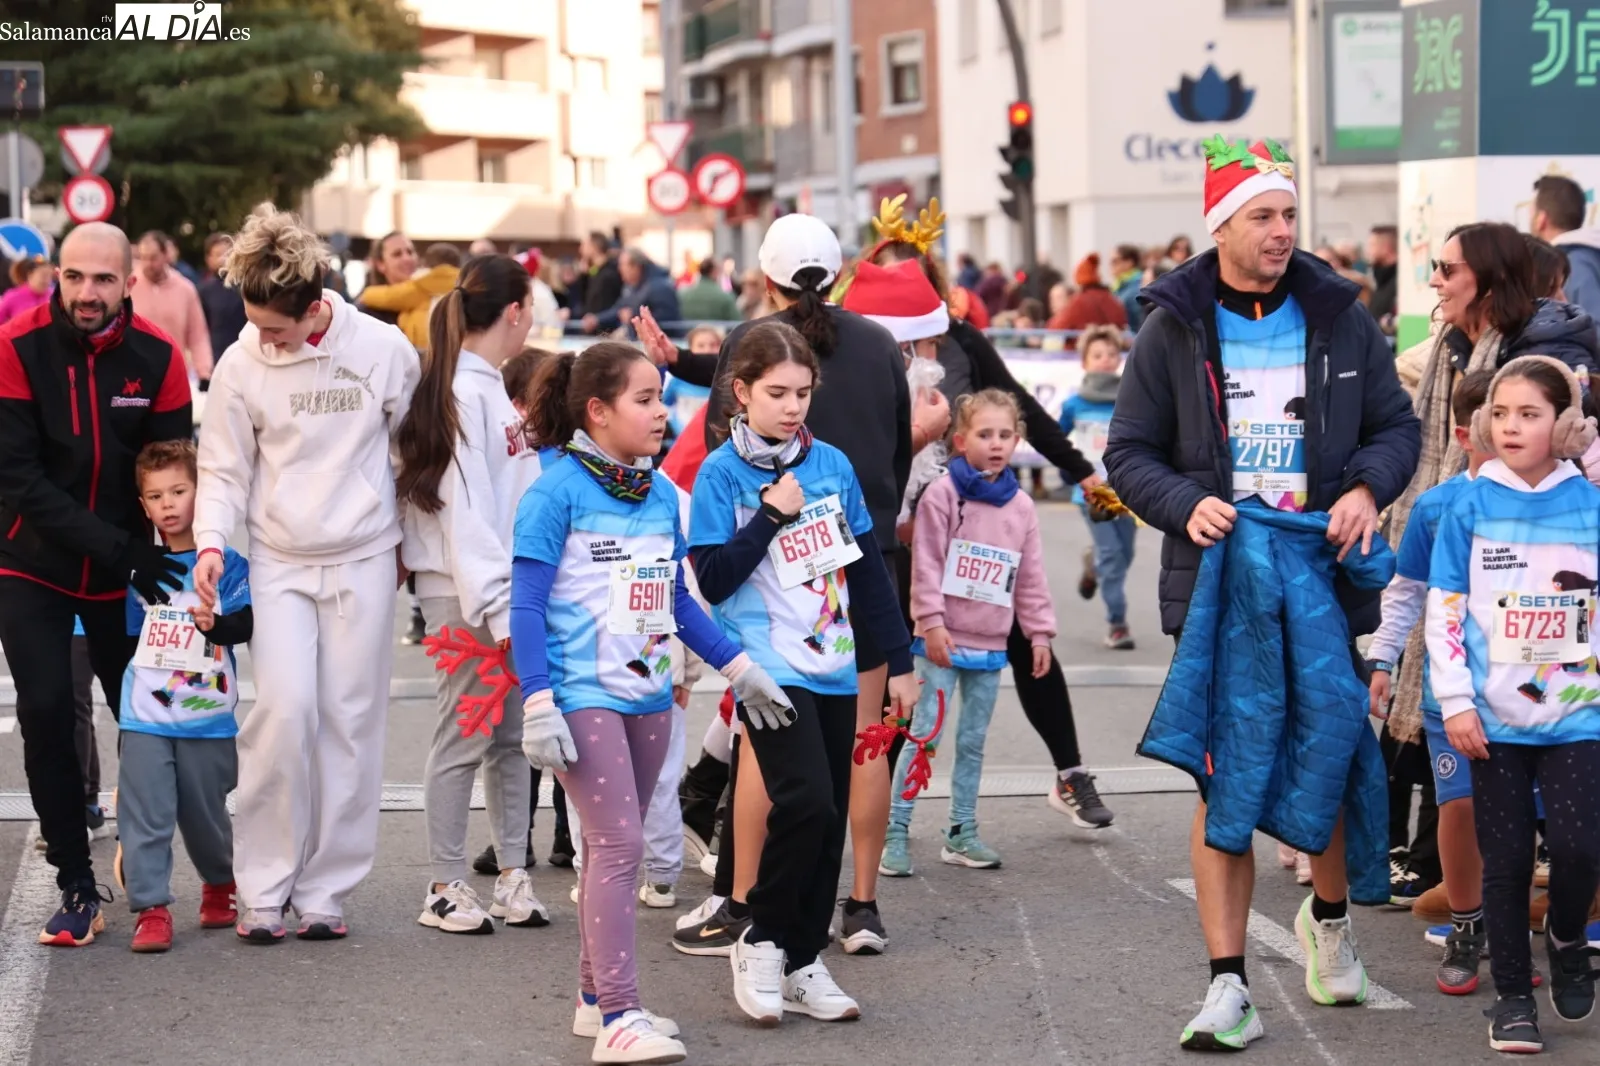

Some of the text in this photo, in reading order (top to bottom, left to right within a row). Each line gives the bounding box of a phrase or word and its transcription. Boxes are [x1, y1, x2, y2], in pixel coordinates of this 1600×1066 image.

[1236, 439, 1296, 467] 2797
[779, 520, 833, 563] 6578
[970, 545, 1013, 563] SETEL
[956, 555, 1004, 586] 6672
[1482, 554, 1518, 562] SILVESTRE
[1482, 561, 1529, 570] SALMANTINA
[637, 566, 671, 579] SETE
[629, 582, 665, 611] 6911
[1519, 595, 1580, 607] SETEL
[146, 623, 196, 650] 6547
[1505, 610, 1566, 639] 6723
